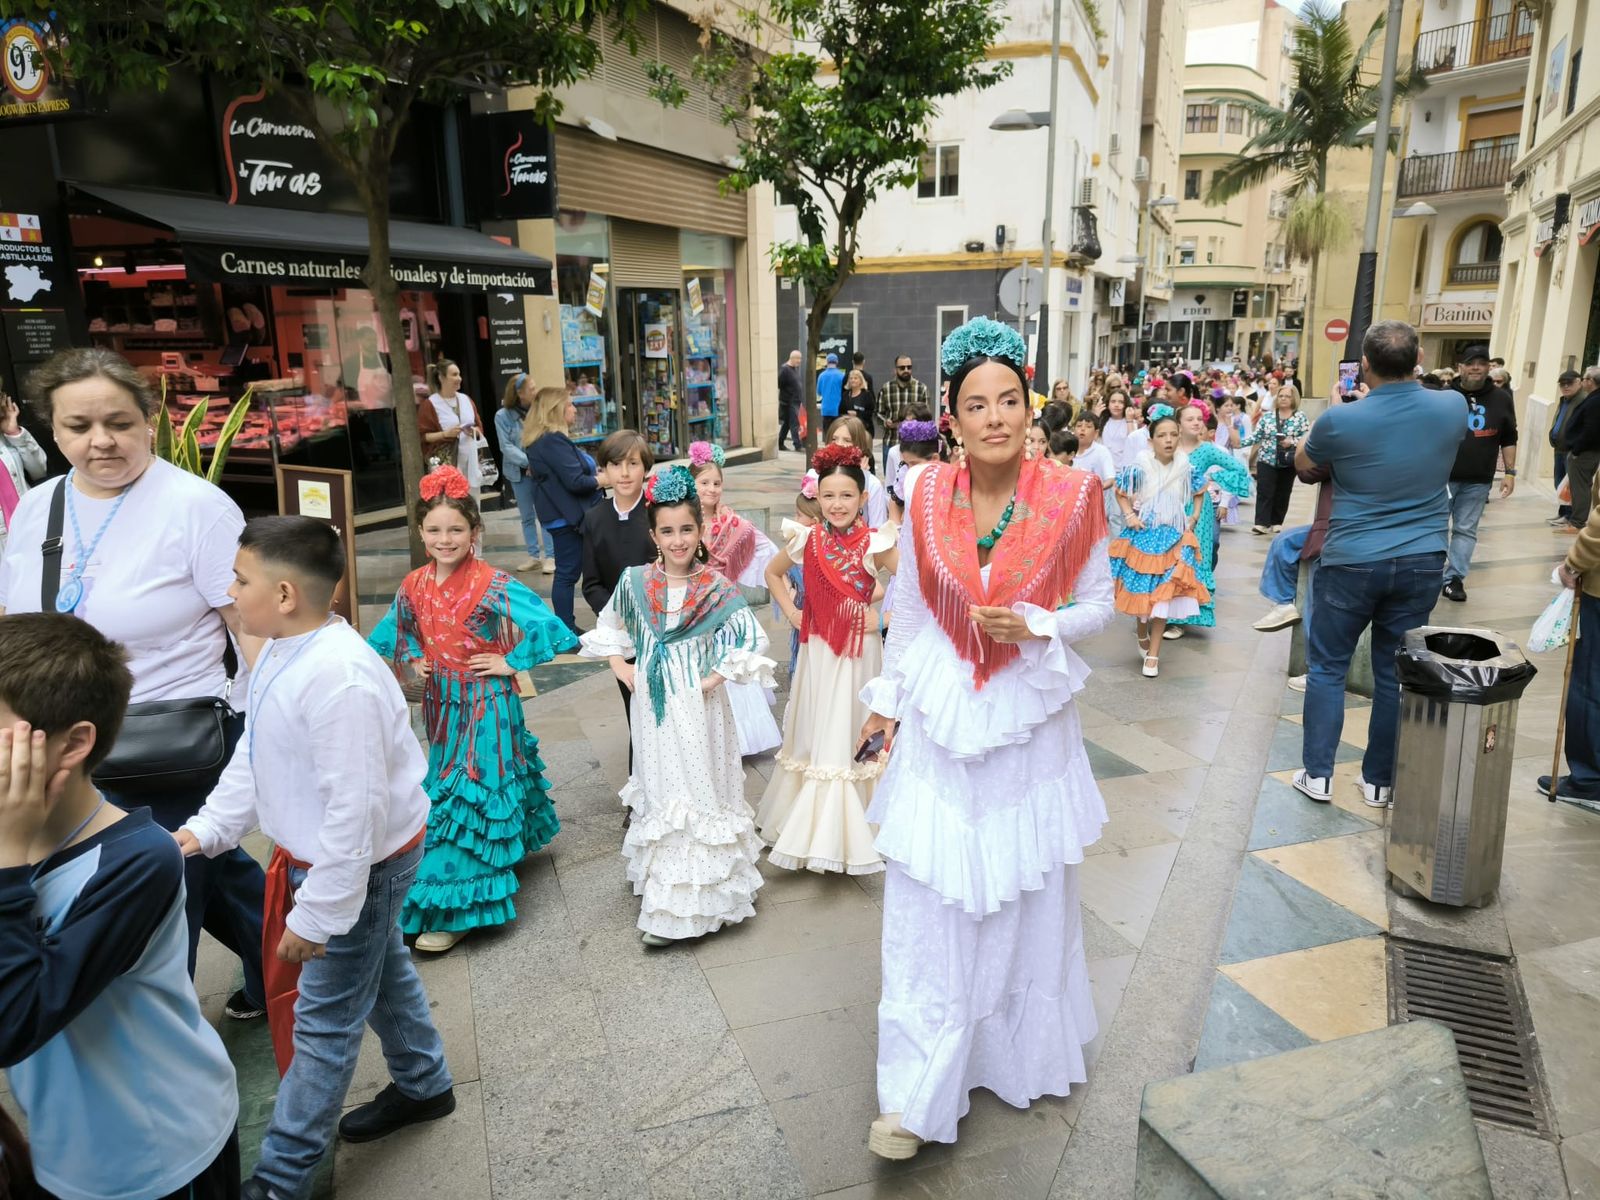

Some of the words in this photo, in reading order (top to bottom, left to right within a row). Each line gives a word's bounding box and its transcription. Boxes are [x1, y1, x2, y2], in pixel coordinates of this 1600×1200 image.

[0, 102, 38, 116] OGWARTS
[38, 99, 70, 113] EXPRESS
[0, 253, 54, 262] ASTILLA-LEÓN
[41, 246, 52, 254] DE
[220, 252, 286, 276] Carnes
[288, 259, 361, 280] naturales
[389, 264, 438, 283] ionales
[439, 271, 448, 288] y
[450, 266, 465, 284] de
[466, 269, 536, 290] importación
[1434, 306, 1493, 321] Banino
